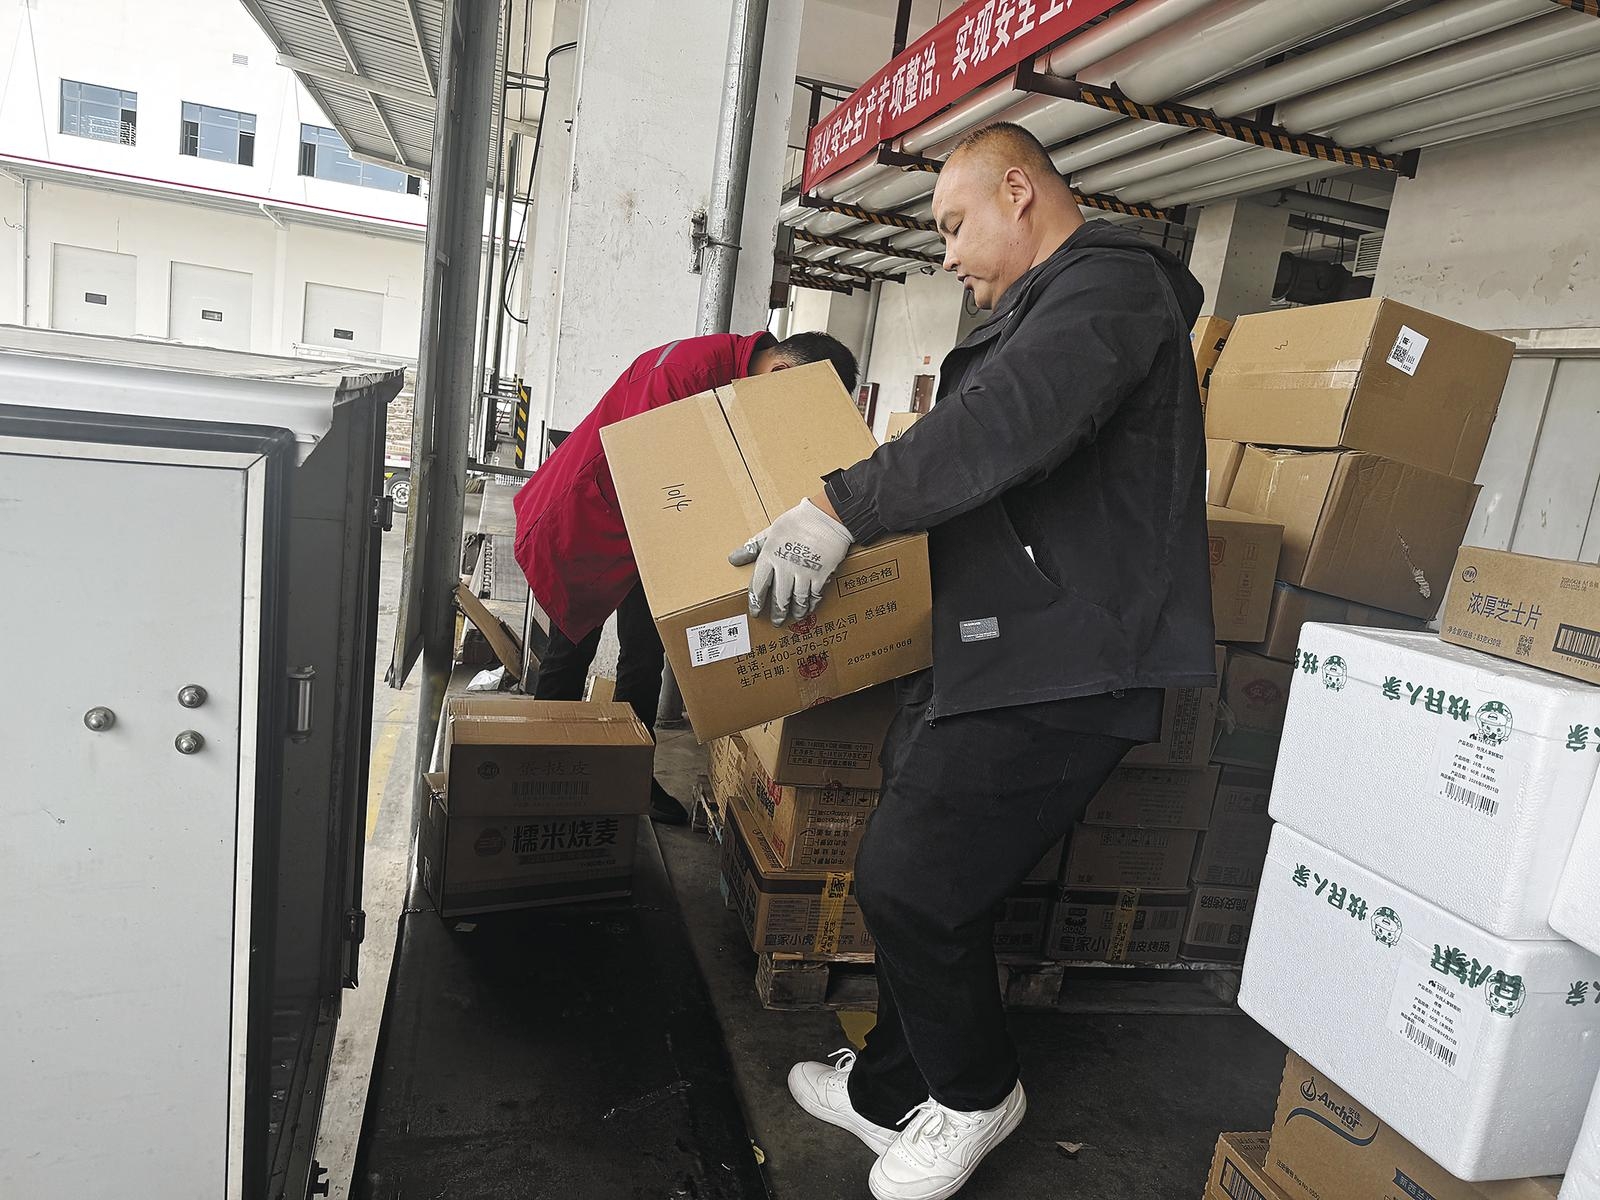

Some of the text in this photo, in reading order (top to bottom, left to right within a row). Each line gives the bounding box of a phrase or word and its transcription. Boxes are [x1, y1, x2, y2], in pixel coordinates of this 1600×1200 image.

[844, 567, 893, 591] 检验合格
[1467, 592, 1542, 630] 浓厚芝士片
[733, 613, 858, 664] 上海潮乡源食品有限公司
[864, 600, 898, 620] 总经销
[1383, 676, 1471, 722] 牧民人家
[512, 818, 618, 854] 糯米烧麦
[1292, 863, 1369, 921] 牧民人家
[1060, 936, 1111, 952] 皇家小
[1317, 1091, 1362, 1129] Anchor
